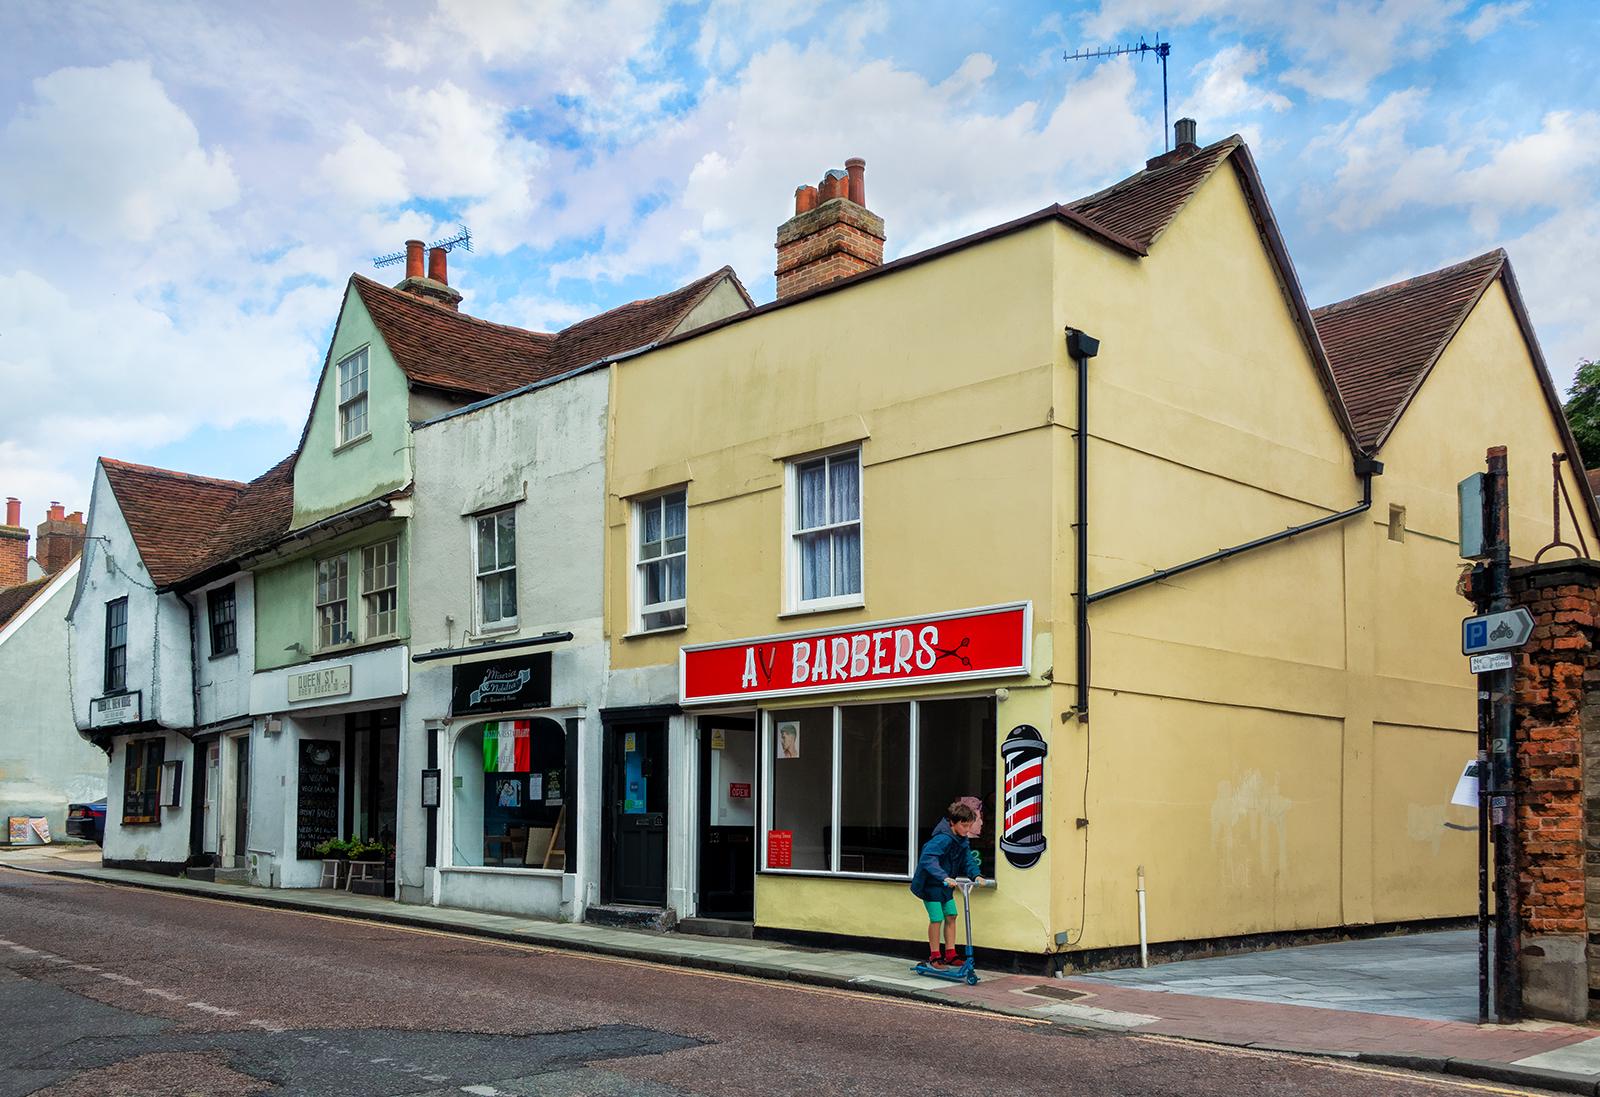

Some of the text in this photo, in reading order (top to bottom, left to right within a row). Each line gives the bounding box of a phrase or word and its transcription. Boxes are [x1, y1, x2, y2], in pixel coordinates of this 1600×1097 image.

[1471, 624, 1483, 646] P
[792, 626, 938, 684] BARBERS
[298, 672, 321, 689] QUEEN
[1495, 740, 1504, 752] 2
[731, 787, 749, 797] OPEN
